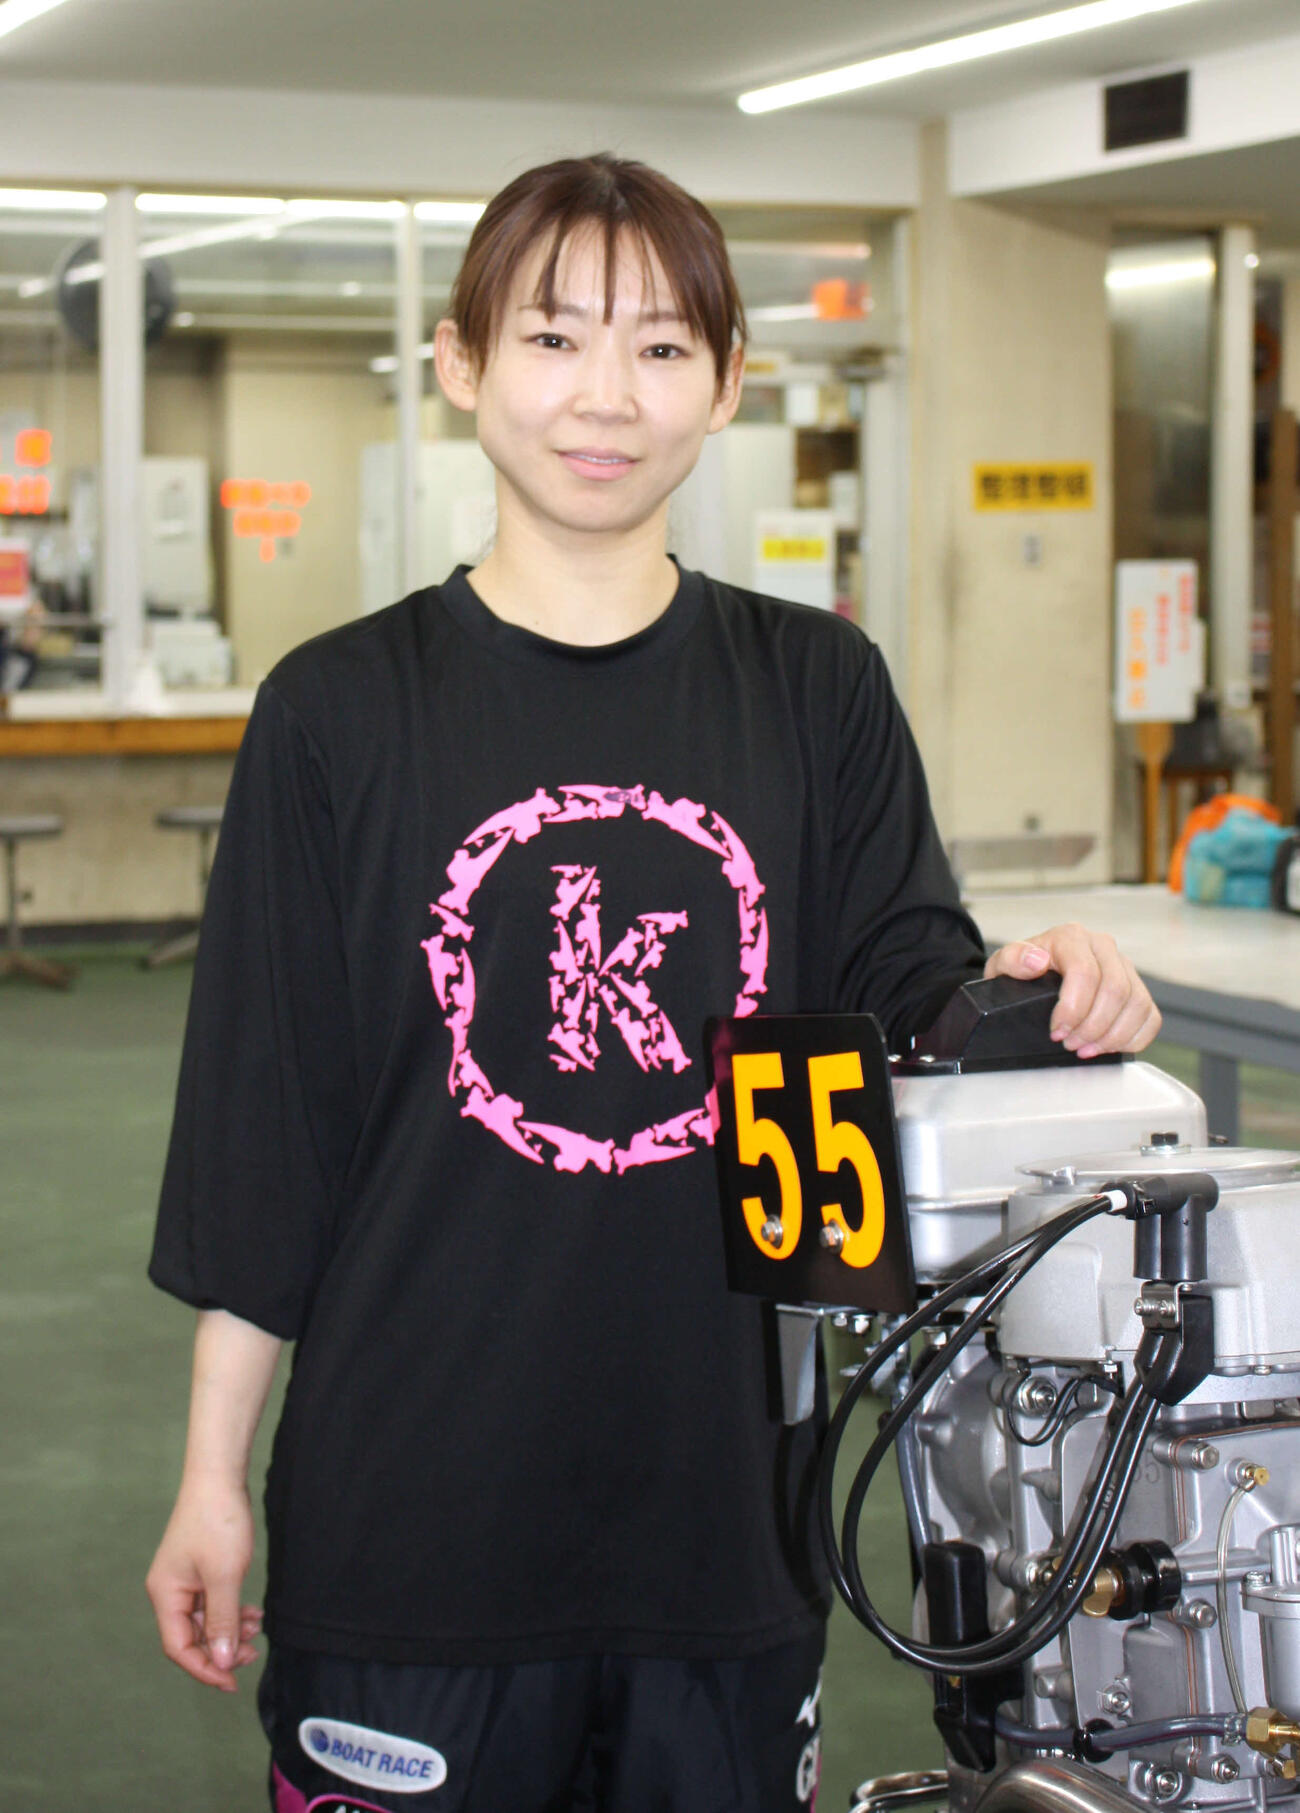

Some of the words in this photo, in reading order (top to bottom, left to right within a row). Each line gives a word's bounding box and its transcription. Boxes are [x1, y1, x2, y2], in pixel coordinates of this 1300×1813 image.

[732, 1051, 885, 1268] 55
[330, 1738, 378, 1769] BOAT
[378, 1753, 434, 1779] RACE
